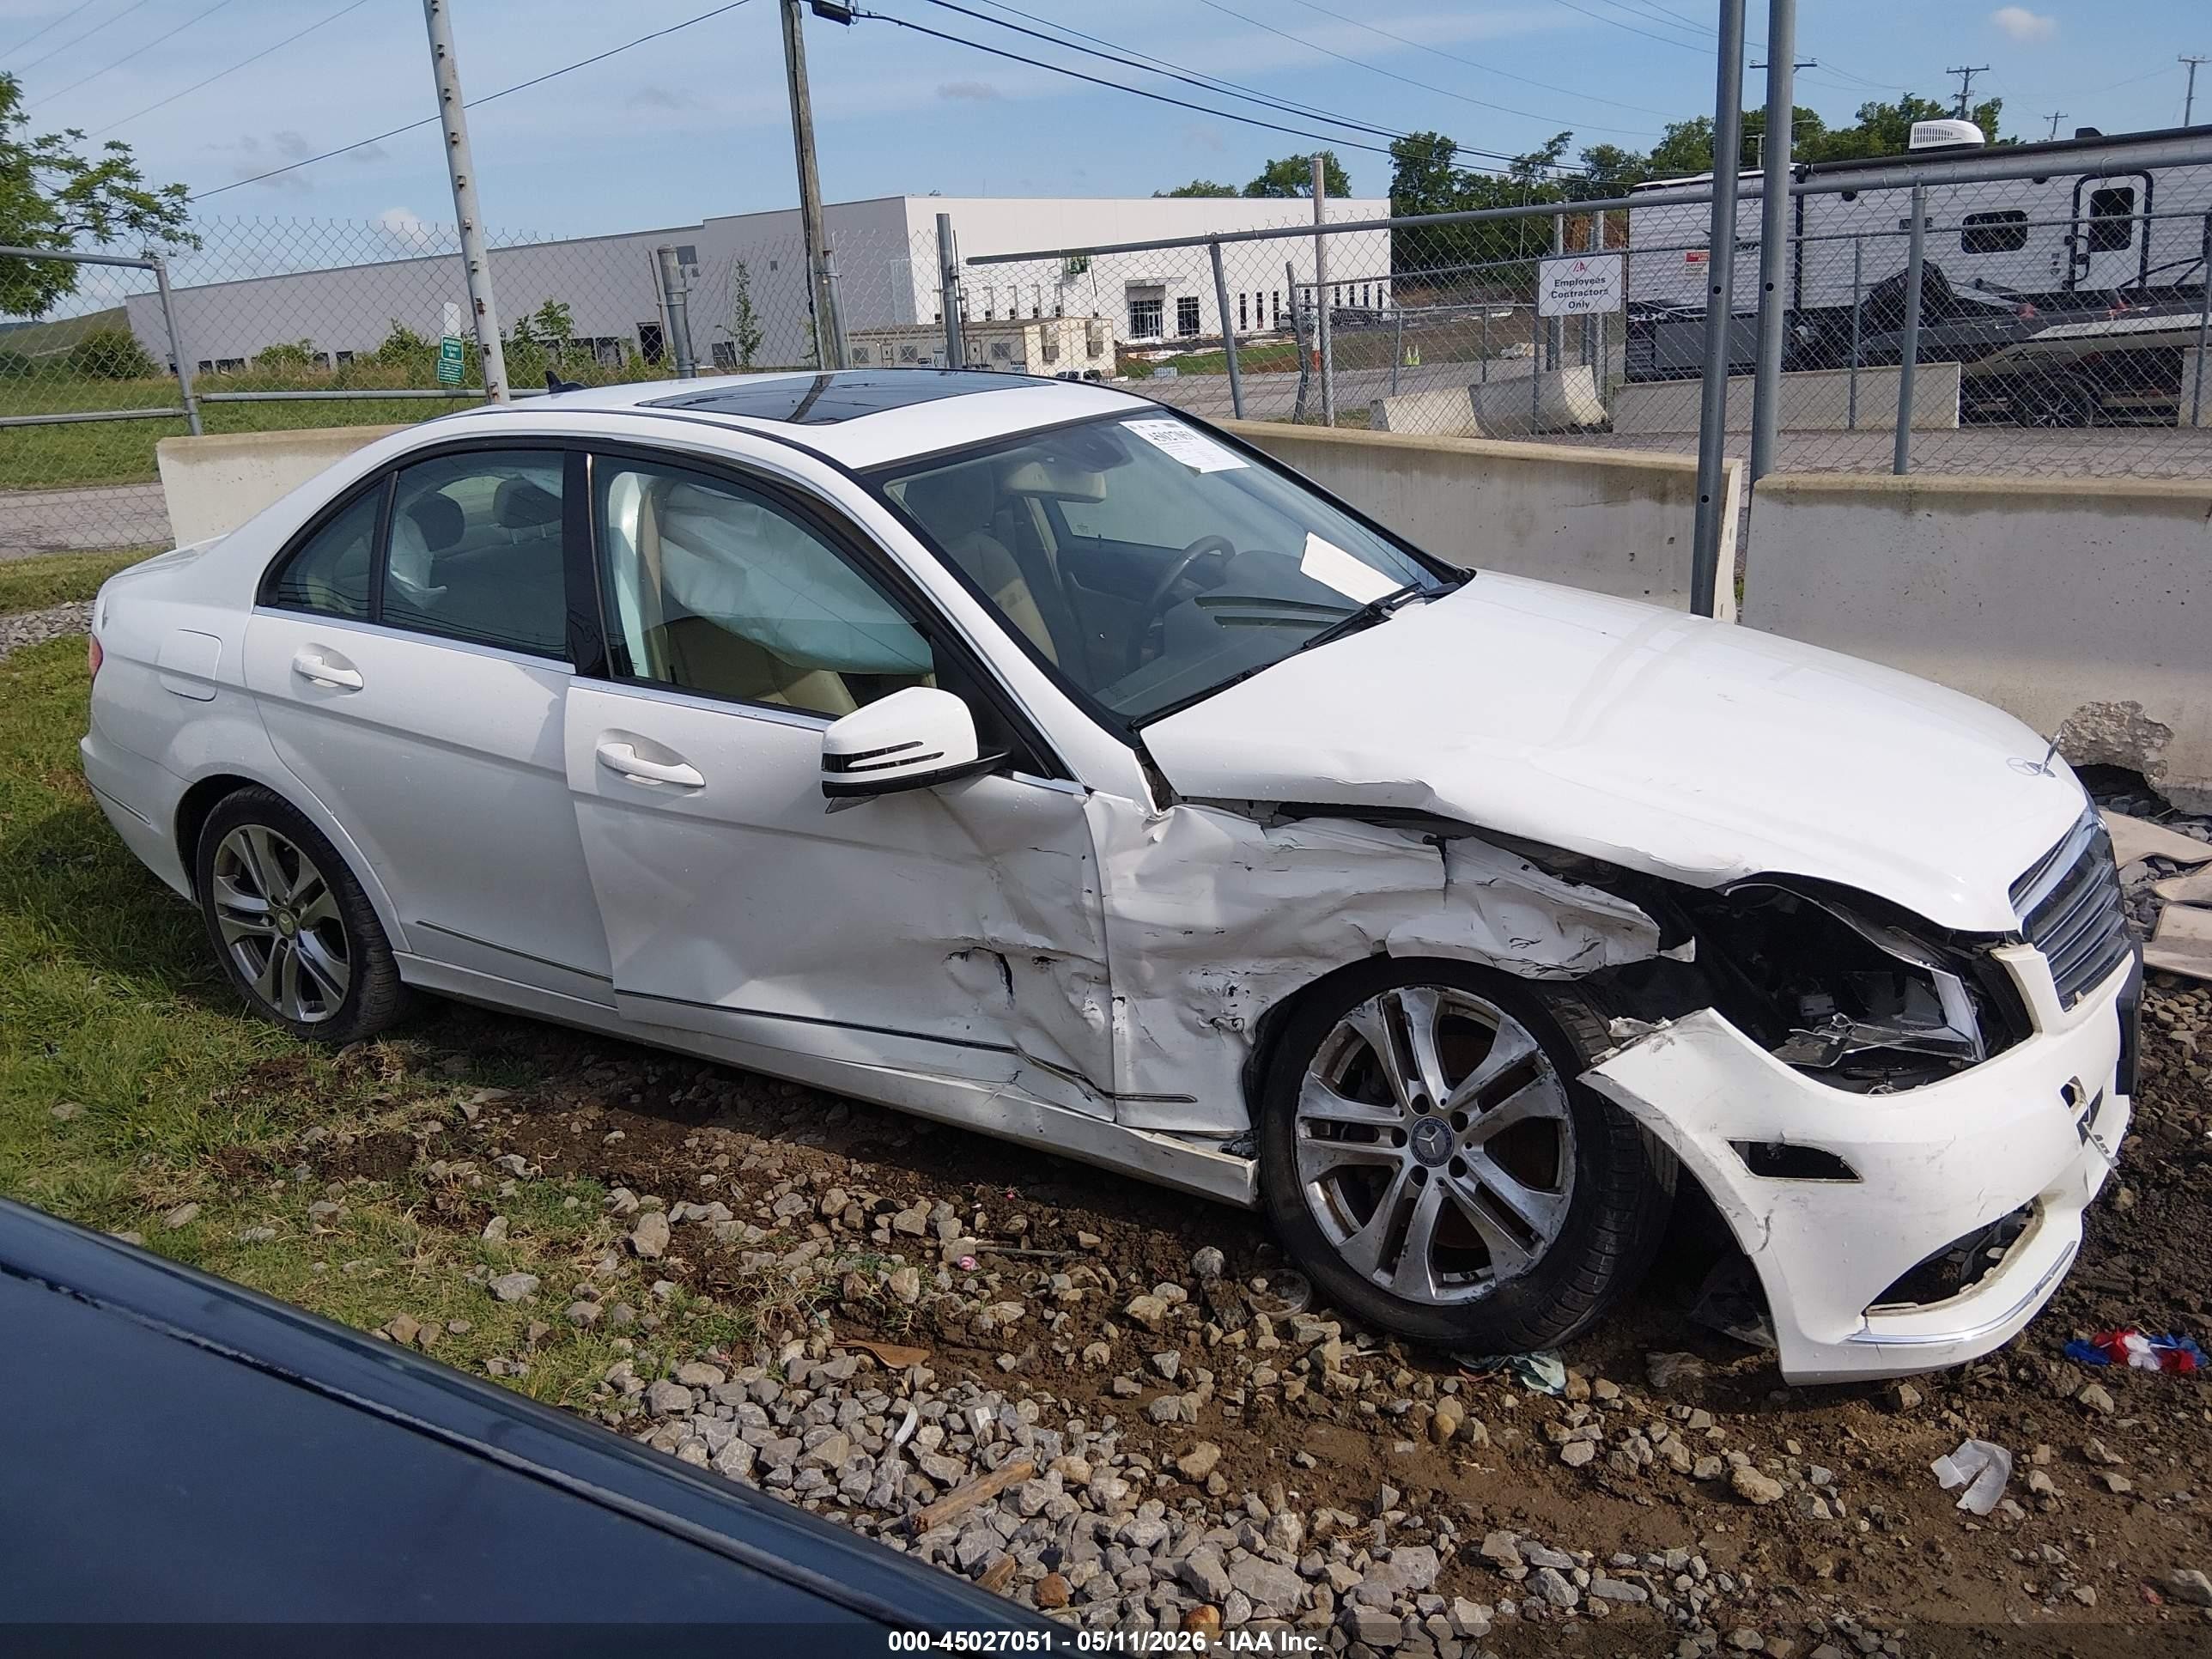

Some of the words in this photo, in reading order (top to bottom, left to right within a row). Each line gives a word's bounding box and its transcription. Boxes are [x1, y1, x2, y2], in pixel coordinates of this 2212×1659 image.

[1554, 276, 1606, 288] Employees
[1551, 289, 1608, 299] Contractors
[1568, 300, 1590, 310] Only
